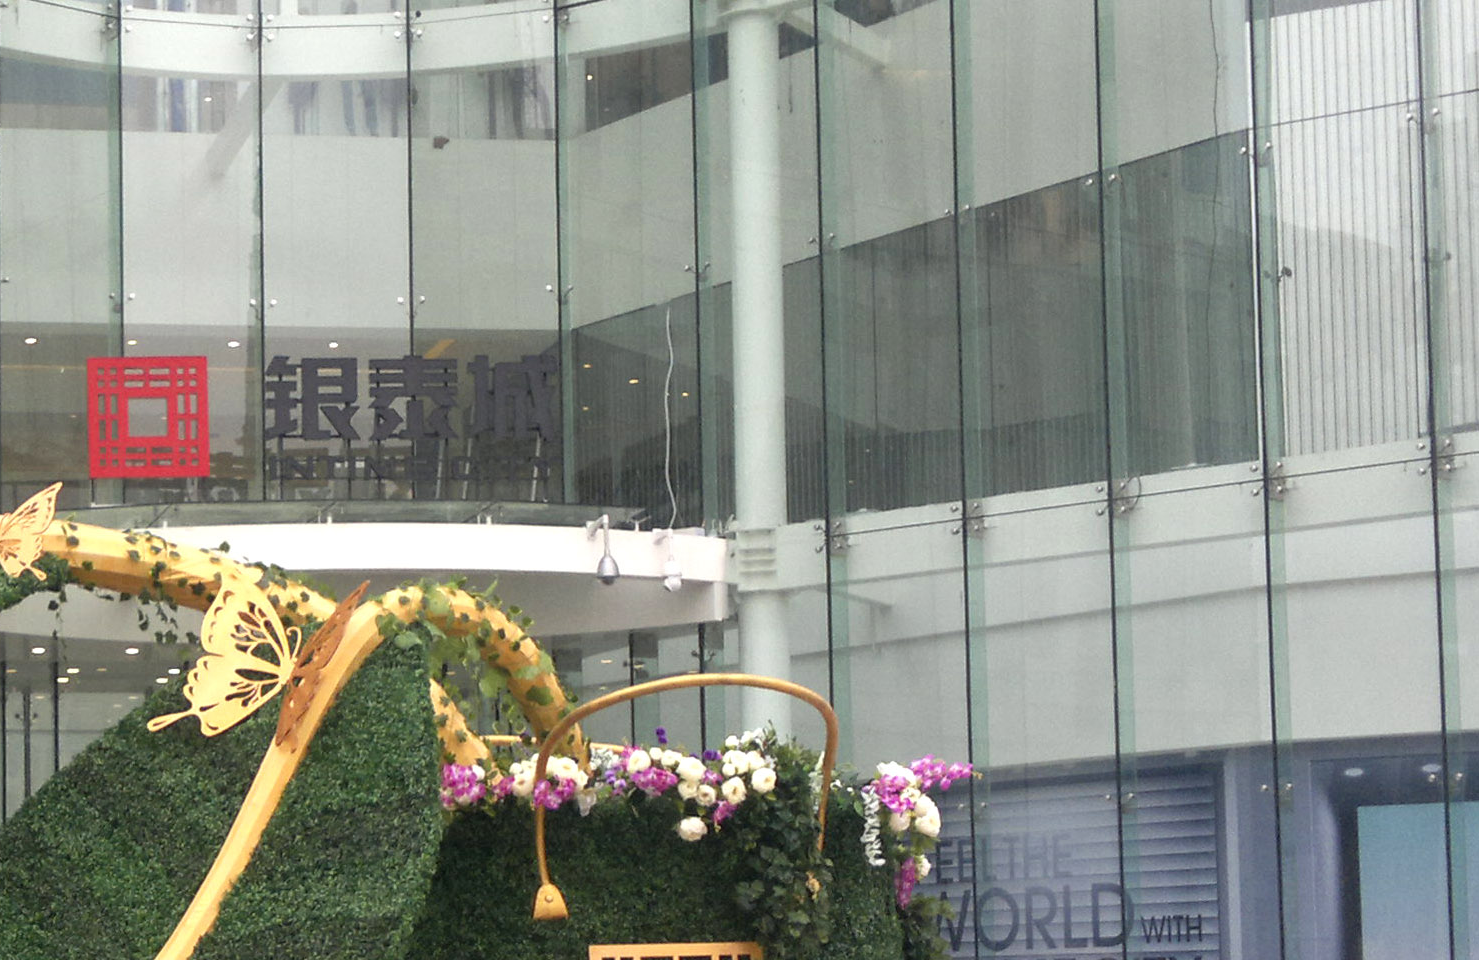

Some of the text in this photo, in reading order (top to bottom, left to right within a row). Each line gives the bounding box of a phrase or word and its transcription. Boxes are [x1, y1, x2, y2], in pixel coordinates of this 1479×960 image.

[264, 354, 558, 441] 银泰城
[936, 832, 1074, 885] EEL THE
[1140, 913, 1203, 944] WITH
